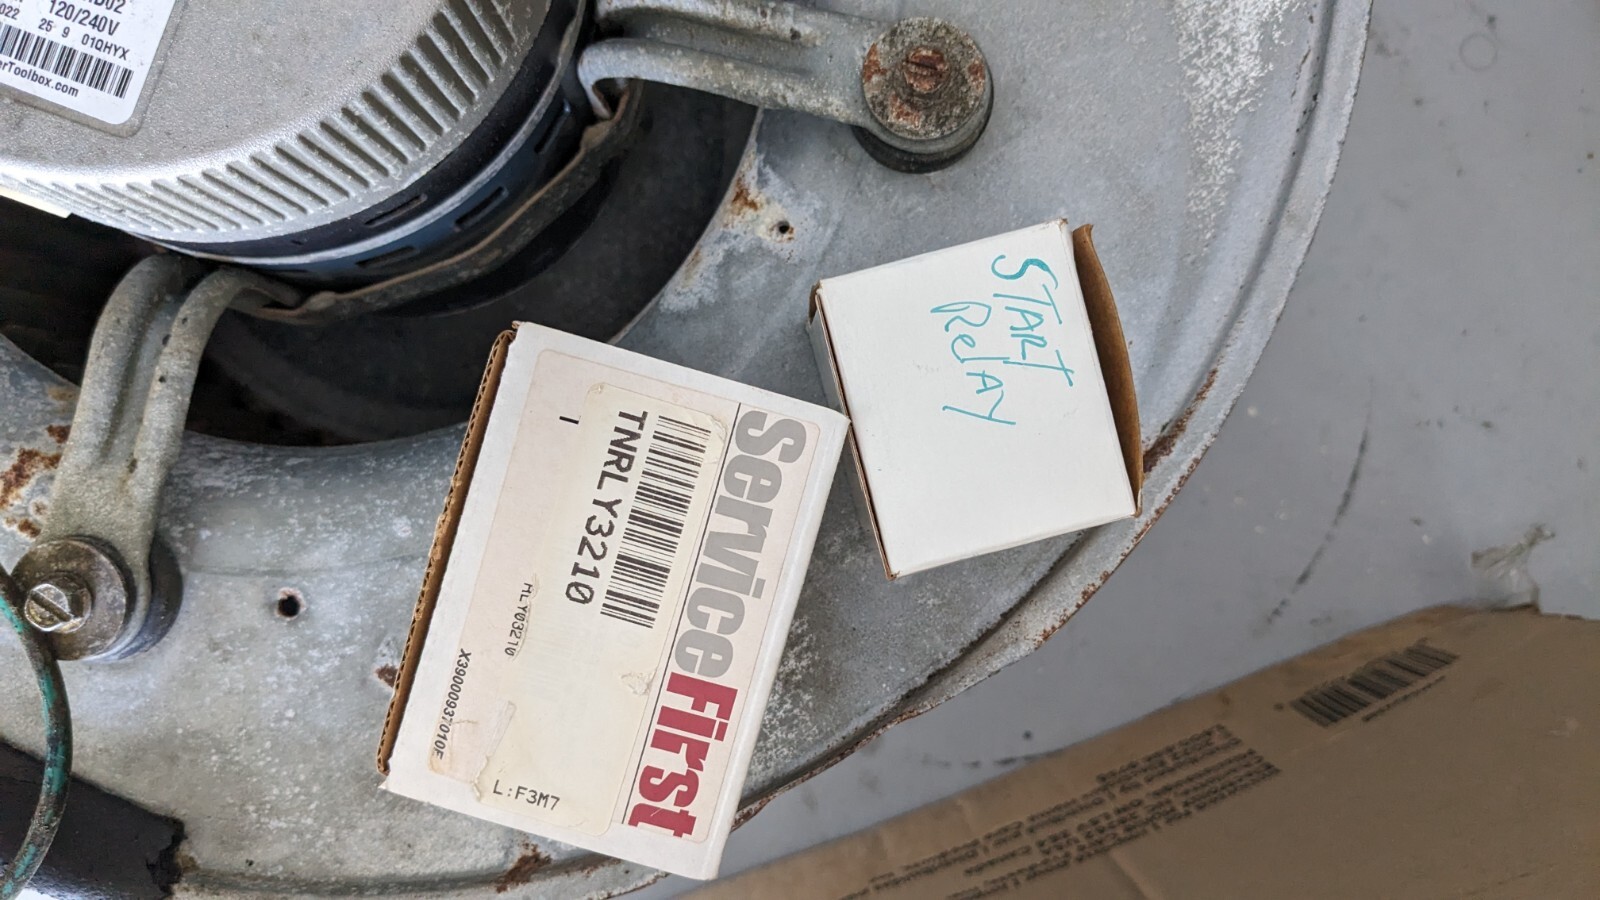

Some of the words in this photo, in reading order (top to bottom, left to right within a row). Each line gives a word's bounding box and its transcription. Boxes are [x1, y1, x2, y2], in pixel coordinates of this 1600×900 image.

[49, 0, 120, 36] 120/240V
[89, 0, 126, 14] 02
[38, 18, 54, 32] 25
[61, 26, 71, 38] 9
[566, 410, 648, 605] TNRLY3210
[493, 779, 561, 811] L:F3M7
